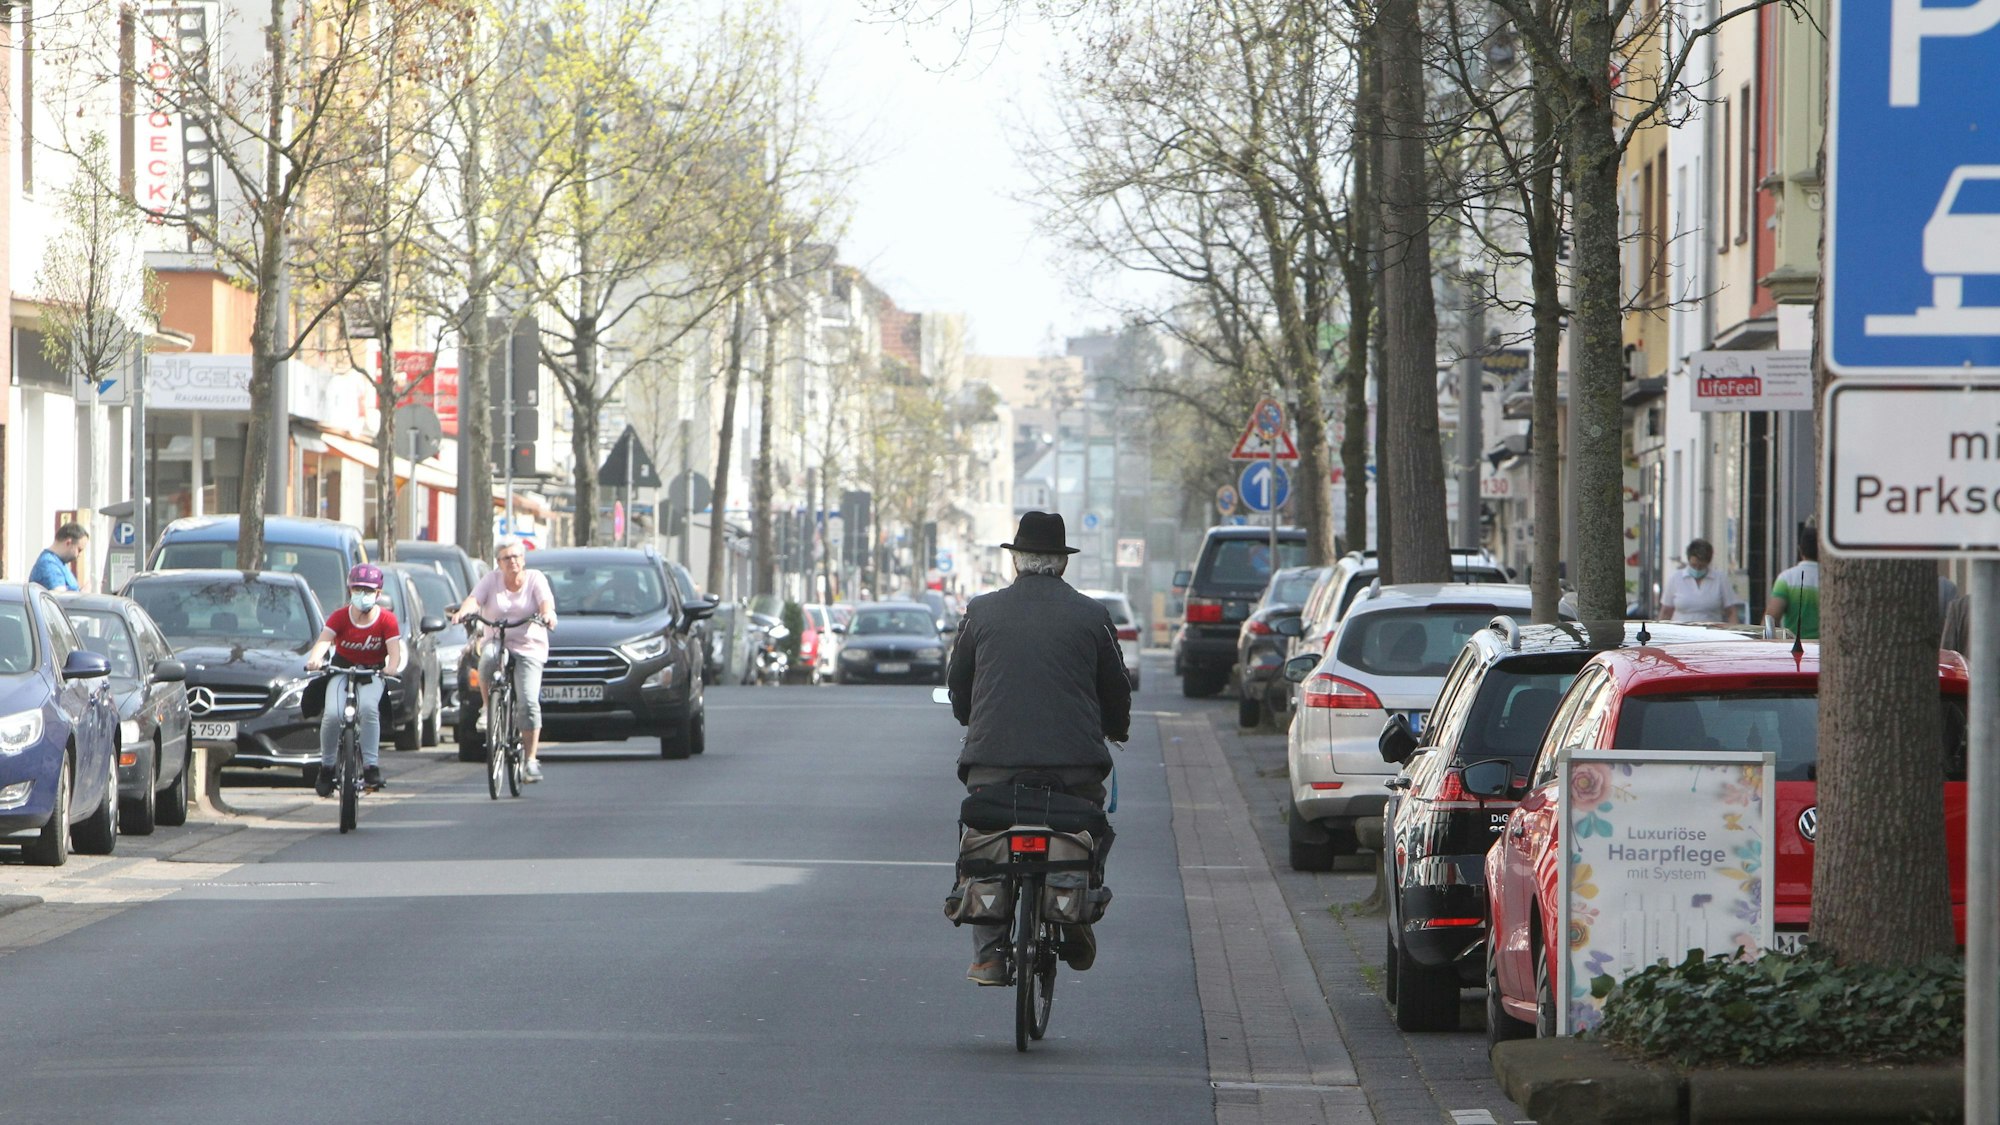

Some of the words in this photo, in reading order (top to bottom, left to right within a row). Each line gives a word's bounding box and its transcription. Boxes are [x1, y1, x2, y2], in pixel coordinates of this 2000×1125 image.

[1701, 380, 1759, 395] LifeFeel
[1481, 479, 1508, 494] 130
[1855, 475, 2000, 514] Parks
[121, 522, 134, 544] P
[541, 687, 554, 698] SU
[562, 688, 574, 698] AT
[578, 687, 601, 698] 1162
[200, 724, 231, 736] 7599
[1628, 826, 1707, 841] Luxuriöse
[1608, 844, 1726, 866] Haarpflege
[1627, 868, 1649, 880] mit
[1653, 867, 1707, 882] System
